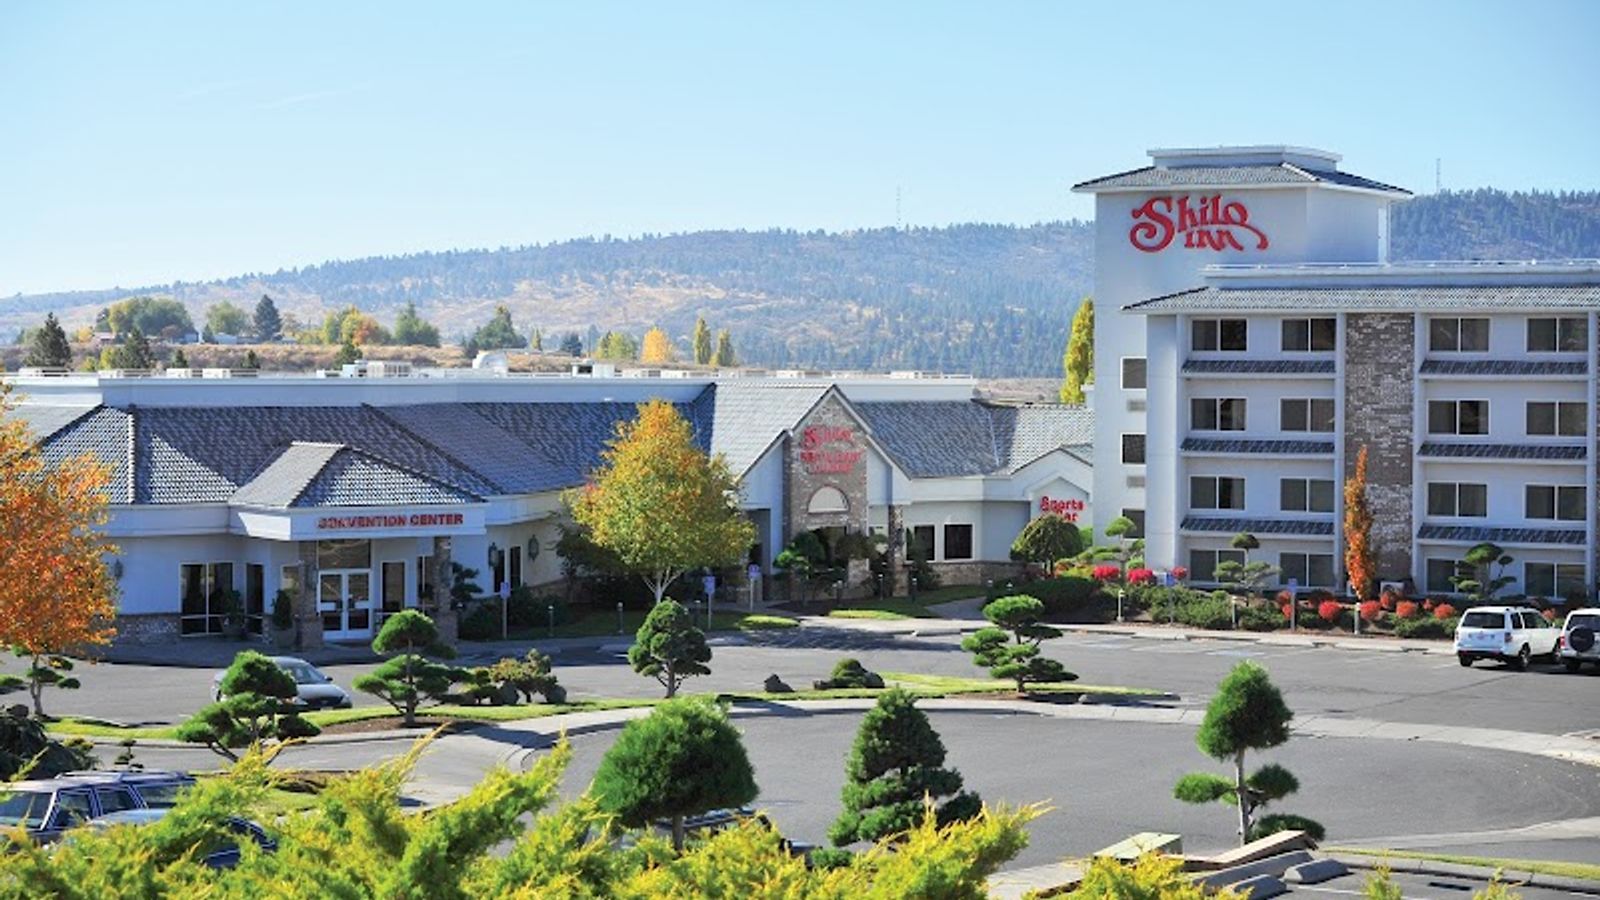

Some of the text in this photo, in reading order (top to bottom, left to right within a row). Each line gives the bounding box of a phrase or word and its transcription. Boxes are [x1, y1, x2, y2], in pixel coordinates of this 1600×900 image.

[1129, 193, 1269, 252] Shilo
[1040, 495, 1084, 512] Sports
[318, 513, 464, 529] CONVENTION CENTER
